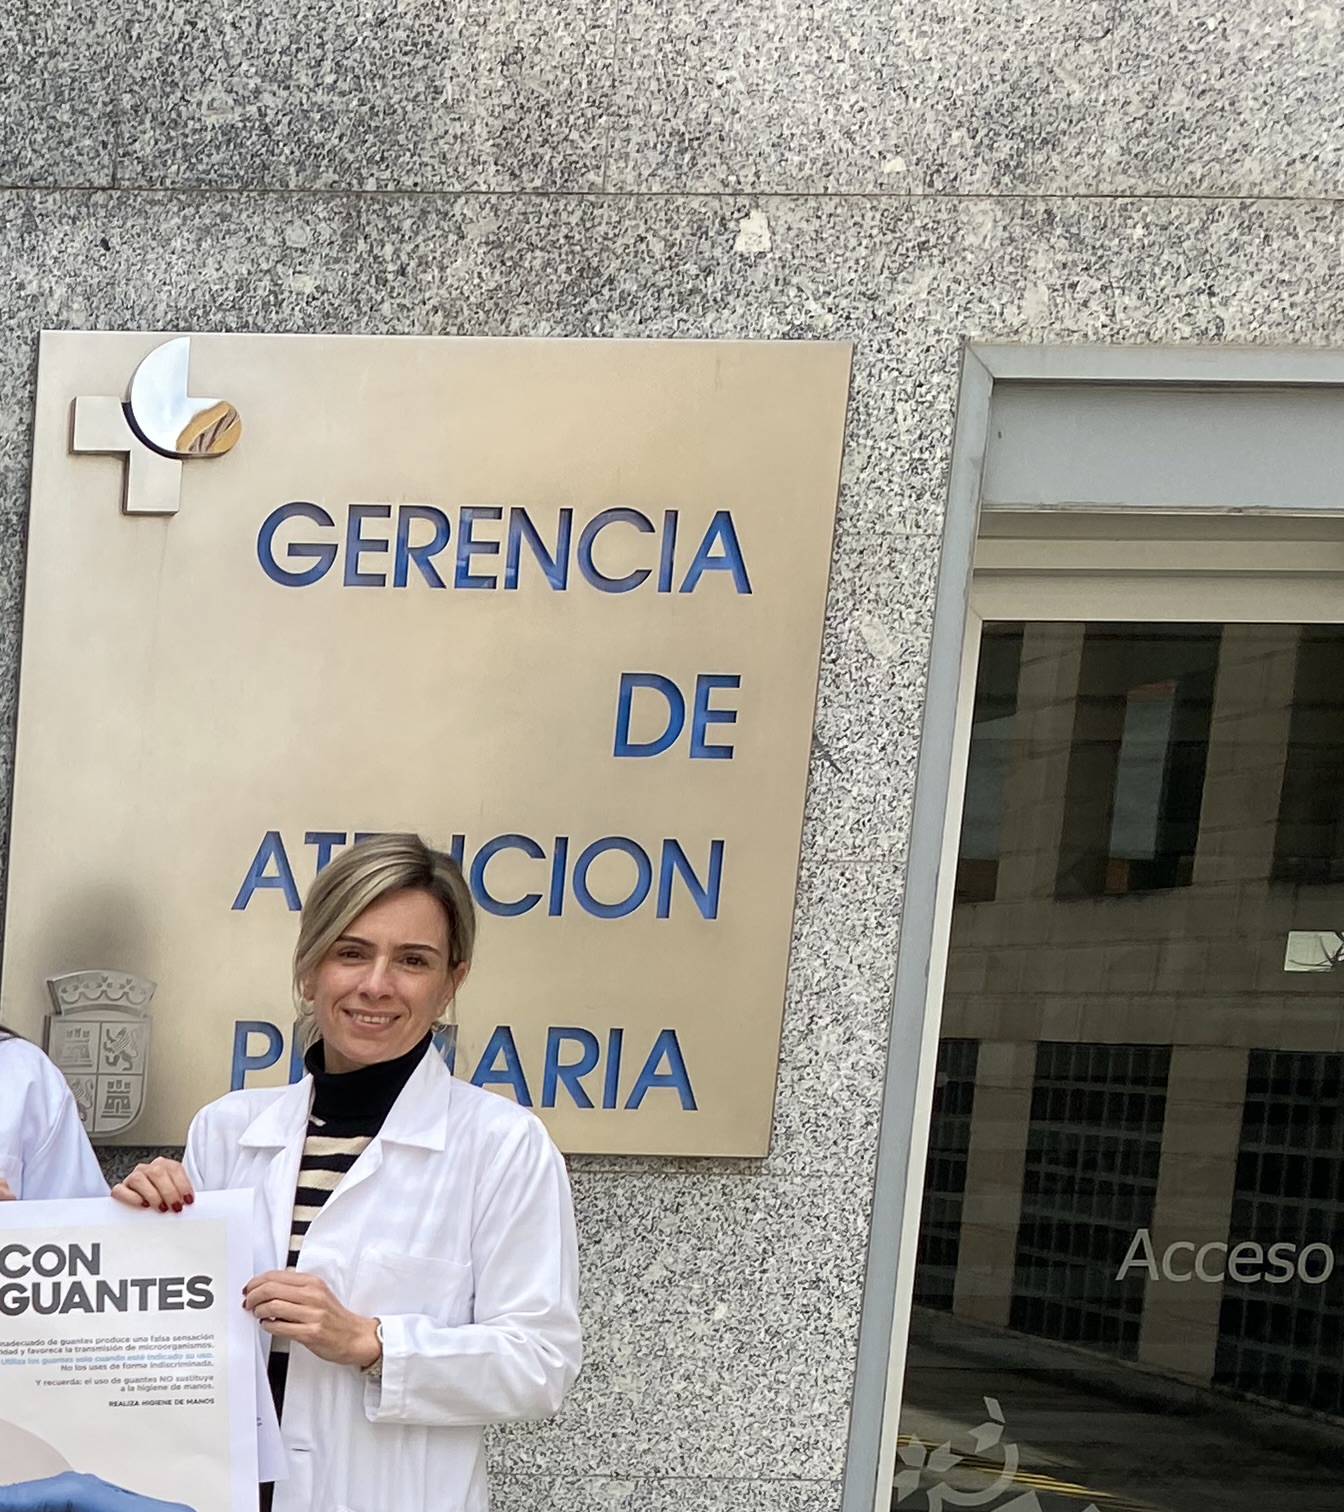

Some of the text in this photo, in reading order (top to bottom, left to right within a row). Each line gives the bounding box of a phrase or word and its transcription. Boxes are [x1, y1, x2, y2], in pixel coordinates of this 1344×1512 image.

[257, 501, 752, 594] GERENCIA
[613, 673, 741, 759] DE
[231, 830, 724, 919] ATCION
[230, 1020, 697, 1111] PARIA
[1115, 1228, 1334, 1284] Acceso
